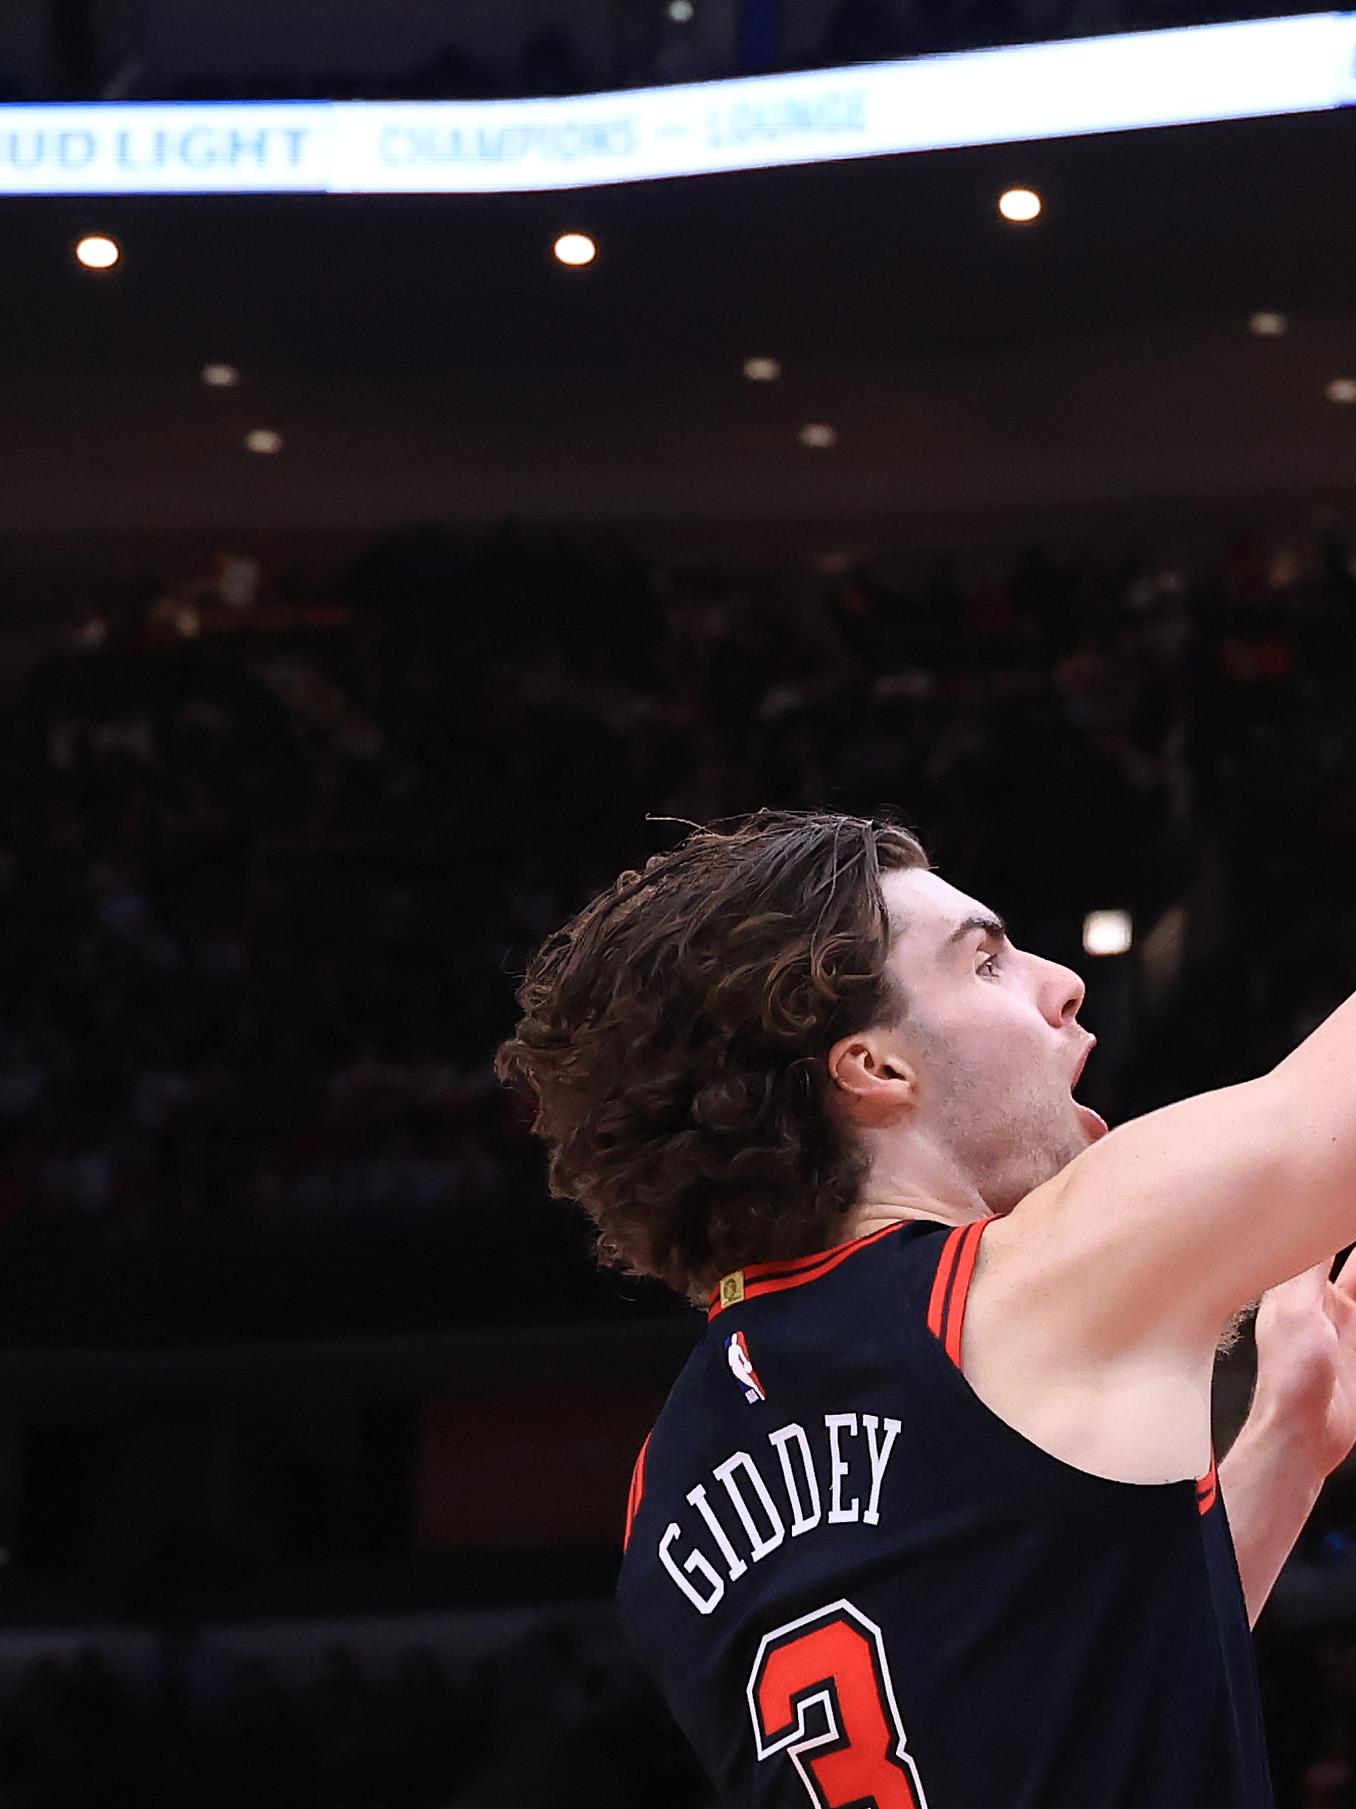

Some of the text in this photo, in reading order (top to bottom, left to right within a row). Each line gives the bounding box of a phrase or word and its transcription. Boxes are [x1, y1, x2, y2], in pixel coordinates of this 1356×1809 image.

[0, 126, 311, 170] UD LIGHT
[658, 1412, 902, 1615] GIDDEY
[746, 1598, 928, 1809] 3
